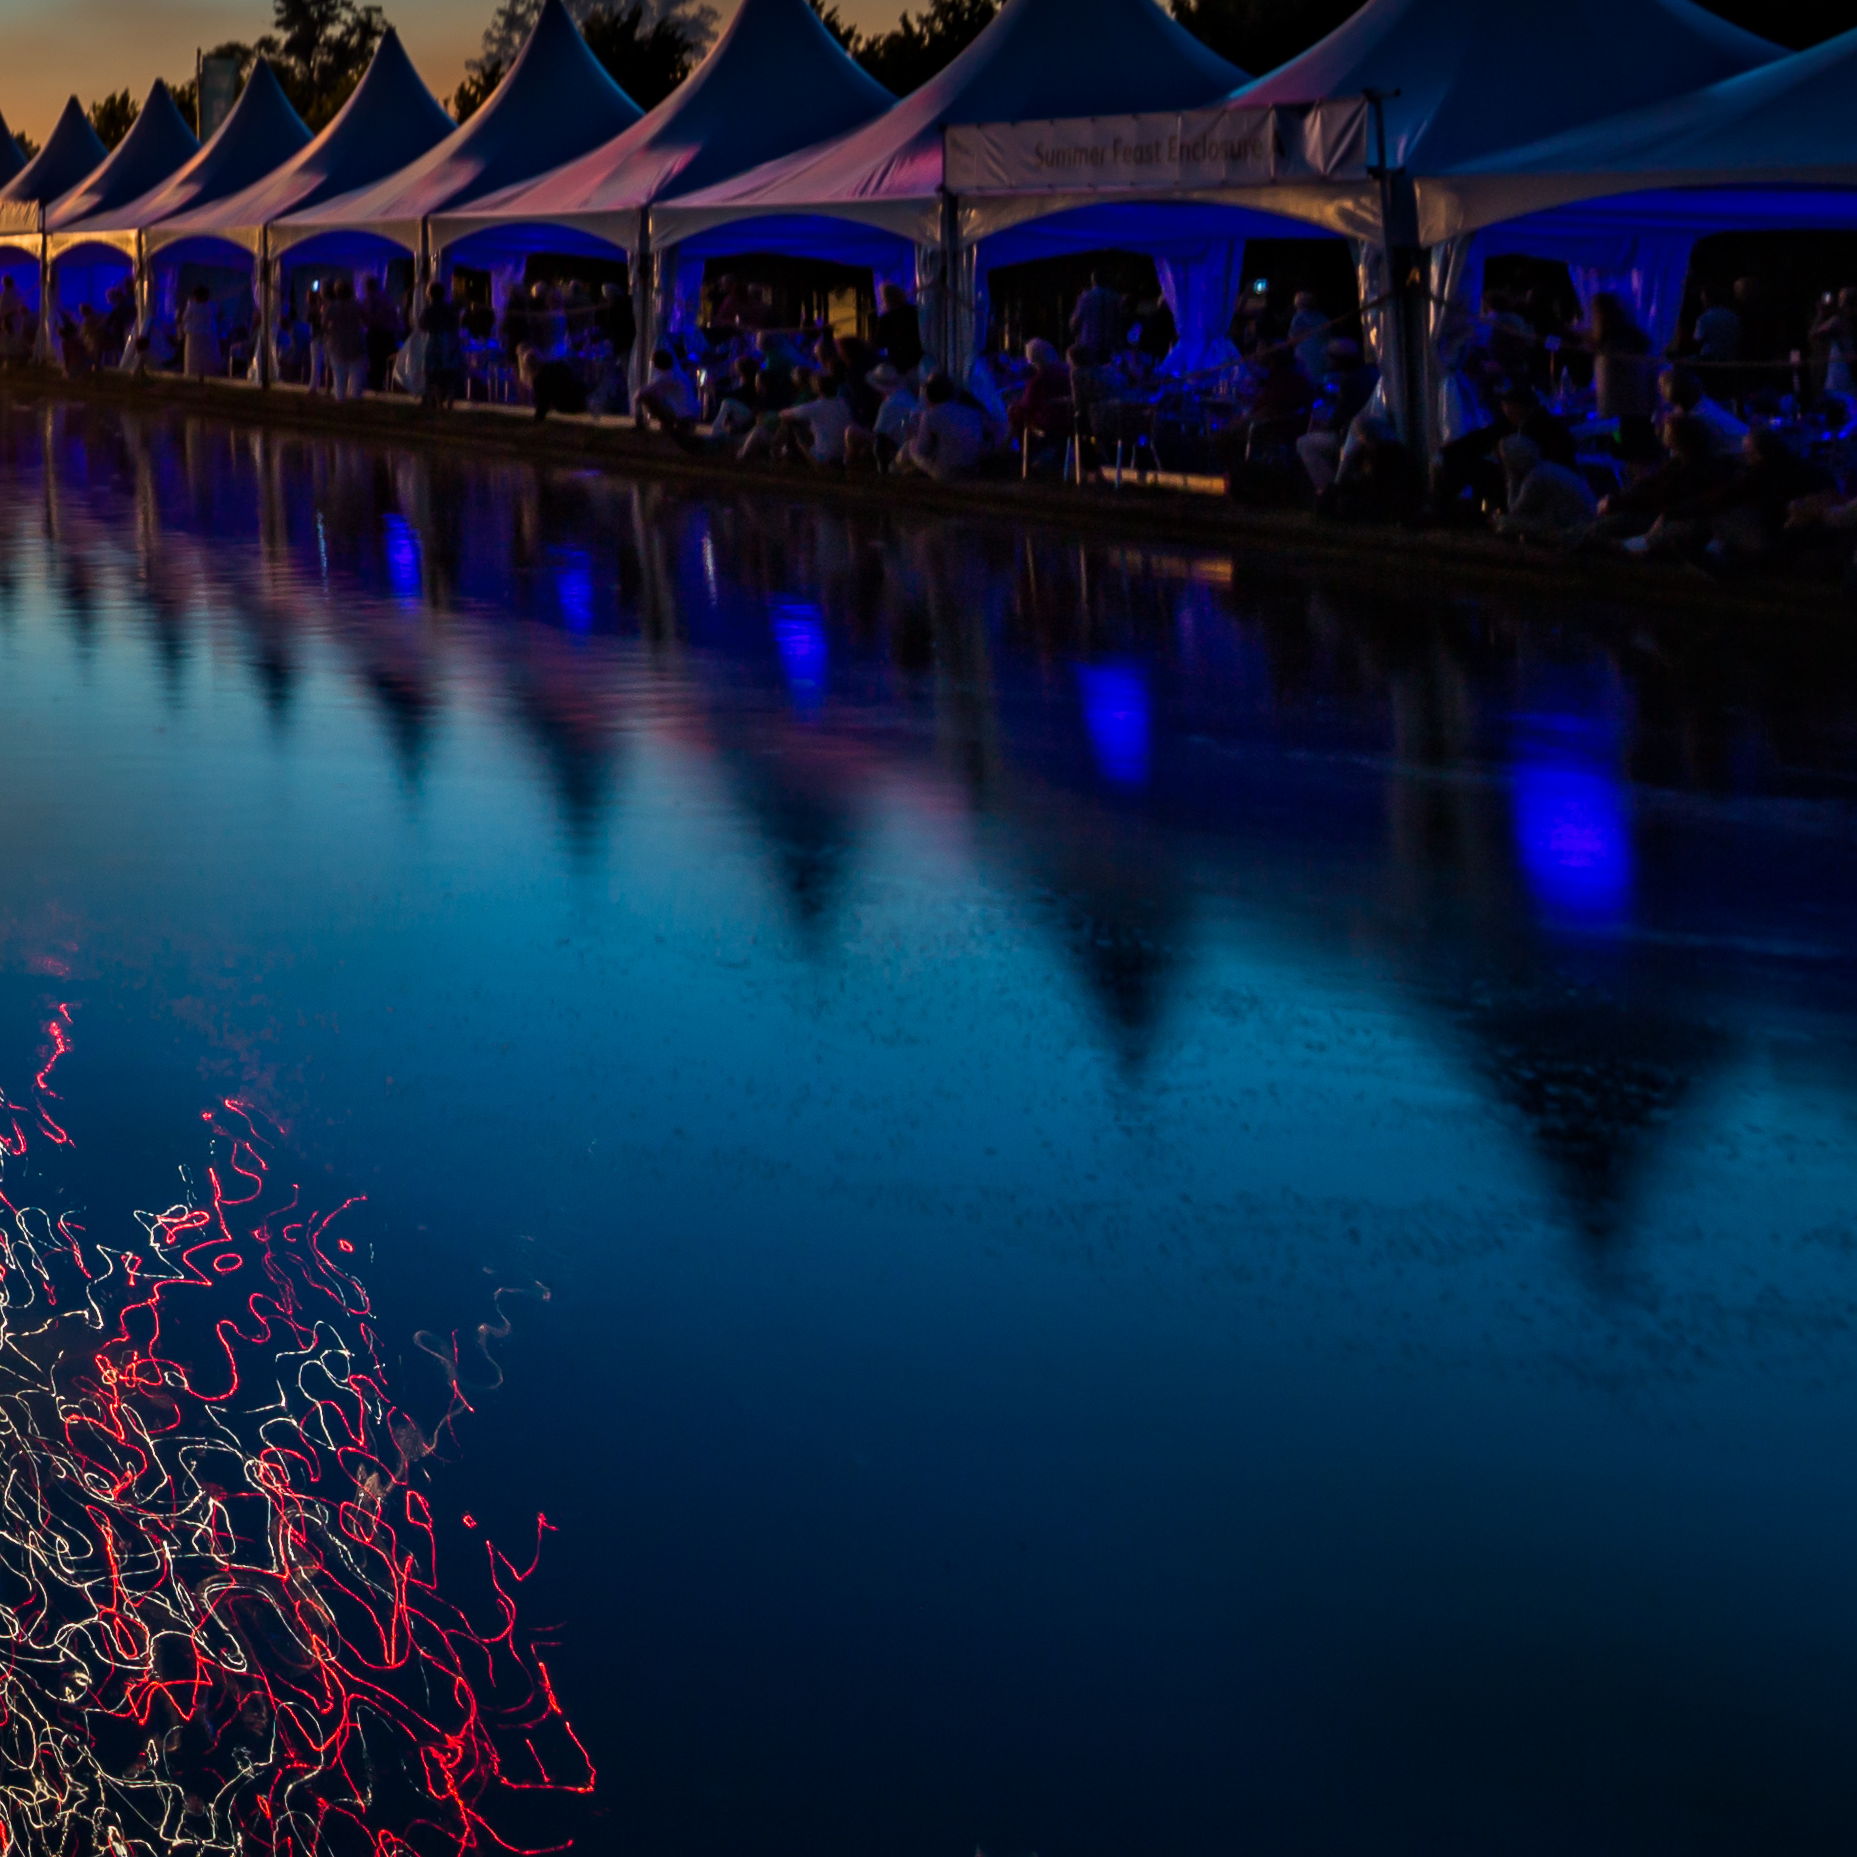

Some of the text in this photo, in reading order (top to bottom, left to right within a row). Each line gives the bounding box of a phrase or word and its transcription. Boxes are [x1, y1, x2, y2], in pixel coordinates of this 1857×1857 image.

[1034, 141, 1106, 170] Summer
[1113, 137, 1160, 166] Feast
[1168, 132, 1262, 163] Enclosure
